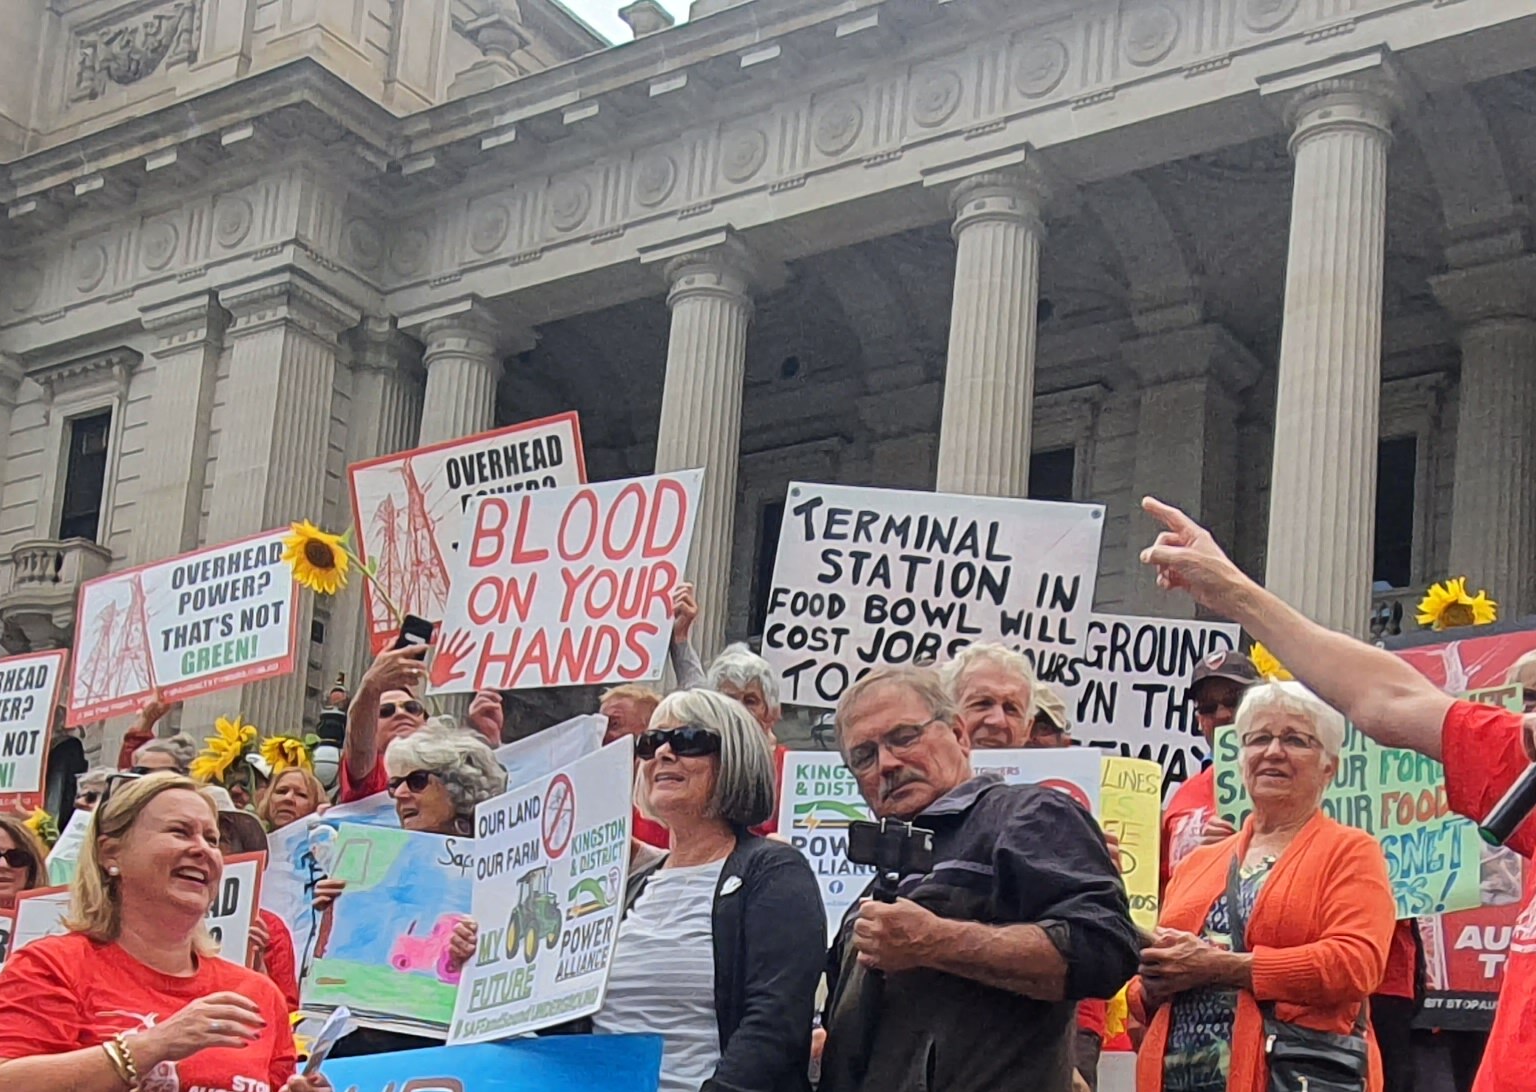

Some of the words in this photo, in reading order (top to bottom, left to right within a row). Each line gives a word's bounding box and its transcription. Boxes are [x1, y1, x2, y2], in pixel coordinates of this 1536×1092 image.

[447, 434, 563, 489] OVERHEAD
[468, 478, 687, 568] BLOOD
[793, 497, 1012, 562] TERMINAL
[172, 542, 282, 592] OVERHEAD
[818, 549, 1011, 606] STATION
[1037, 573, 1080, 613] IN
[178, 571, 272, 615] POWER?
[468, 572, 537, 625] ON
[560, 561, 677, 623] YOUR
[161, 615, 234, 653] THAT'S
[240, 601, 285, 632] NOT
[767, 588, 846, 620] FOOD
[865, 593, 981, 635] BOWL
[1001, 609, 1077, 645] WILL
[180, 635, 259, 676] GREEN!
[475, 622, 658, 689] HANDS
[766, 622, 850, 655] COST
[1085, 622, 1234, 677] GROUND
[782, 659, 874, 701] TO
[1077, 680, 1118, 723] IN
[2, 730, 40, 757] NOT
[796, 782, 808, 796] &
[1102, 759, 1158, 794] LINES
[479, 809, 505, 838] OUR
[509, 796, 541, 829] LAND
[1382, 786, 1449, 830] FOOD
[571, 816, 625, 857] KINGSTON
[580, 843, 624, 872] DISTRICT
[477, 852, 503, 880] OUR
[506, 839, 539, 868] FARM
[476, 927, 504, 964] MY
[561, 916, 613, 957] POWER
[555, 946, 609, 982] ALLIANCE
[468, 963, 536, 1012] FUTURE
